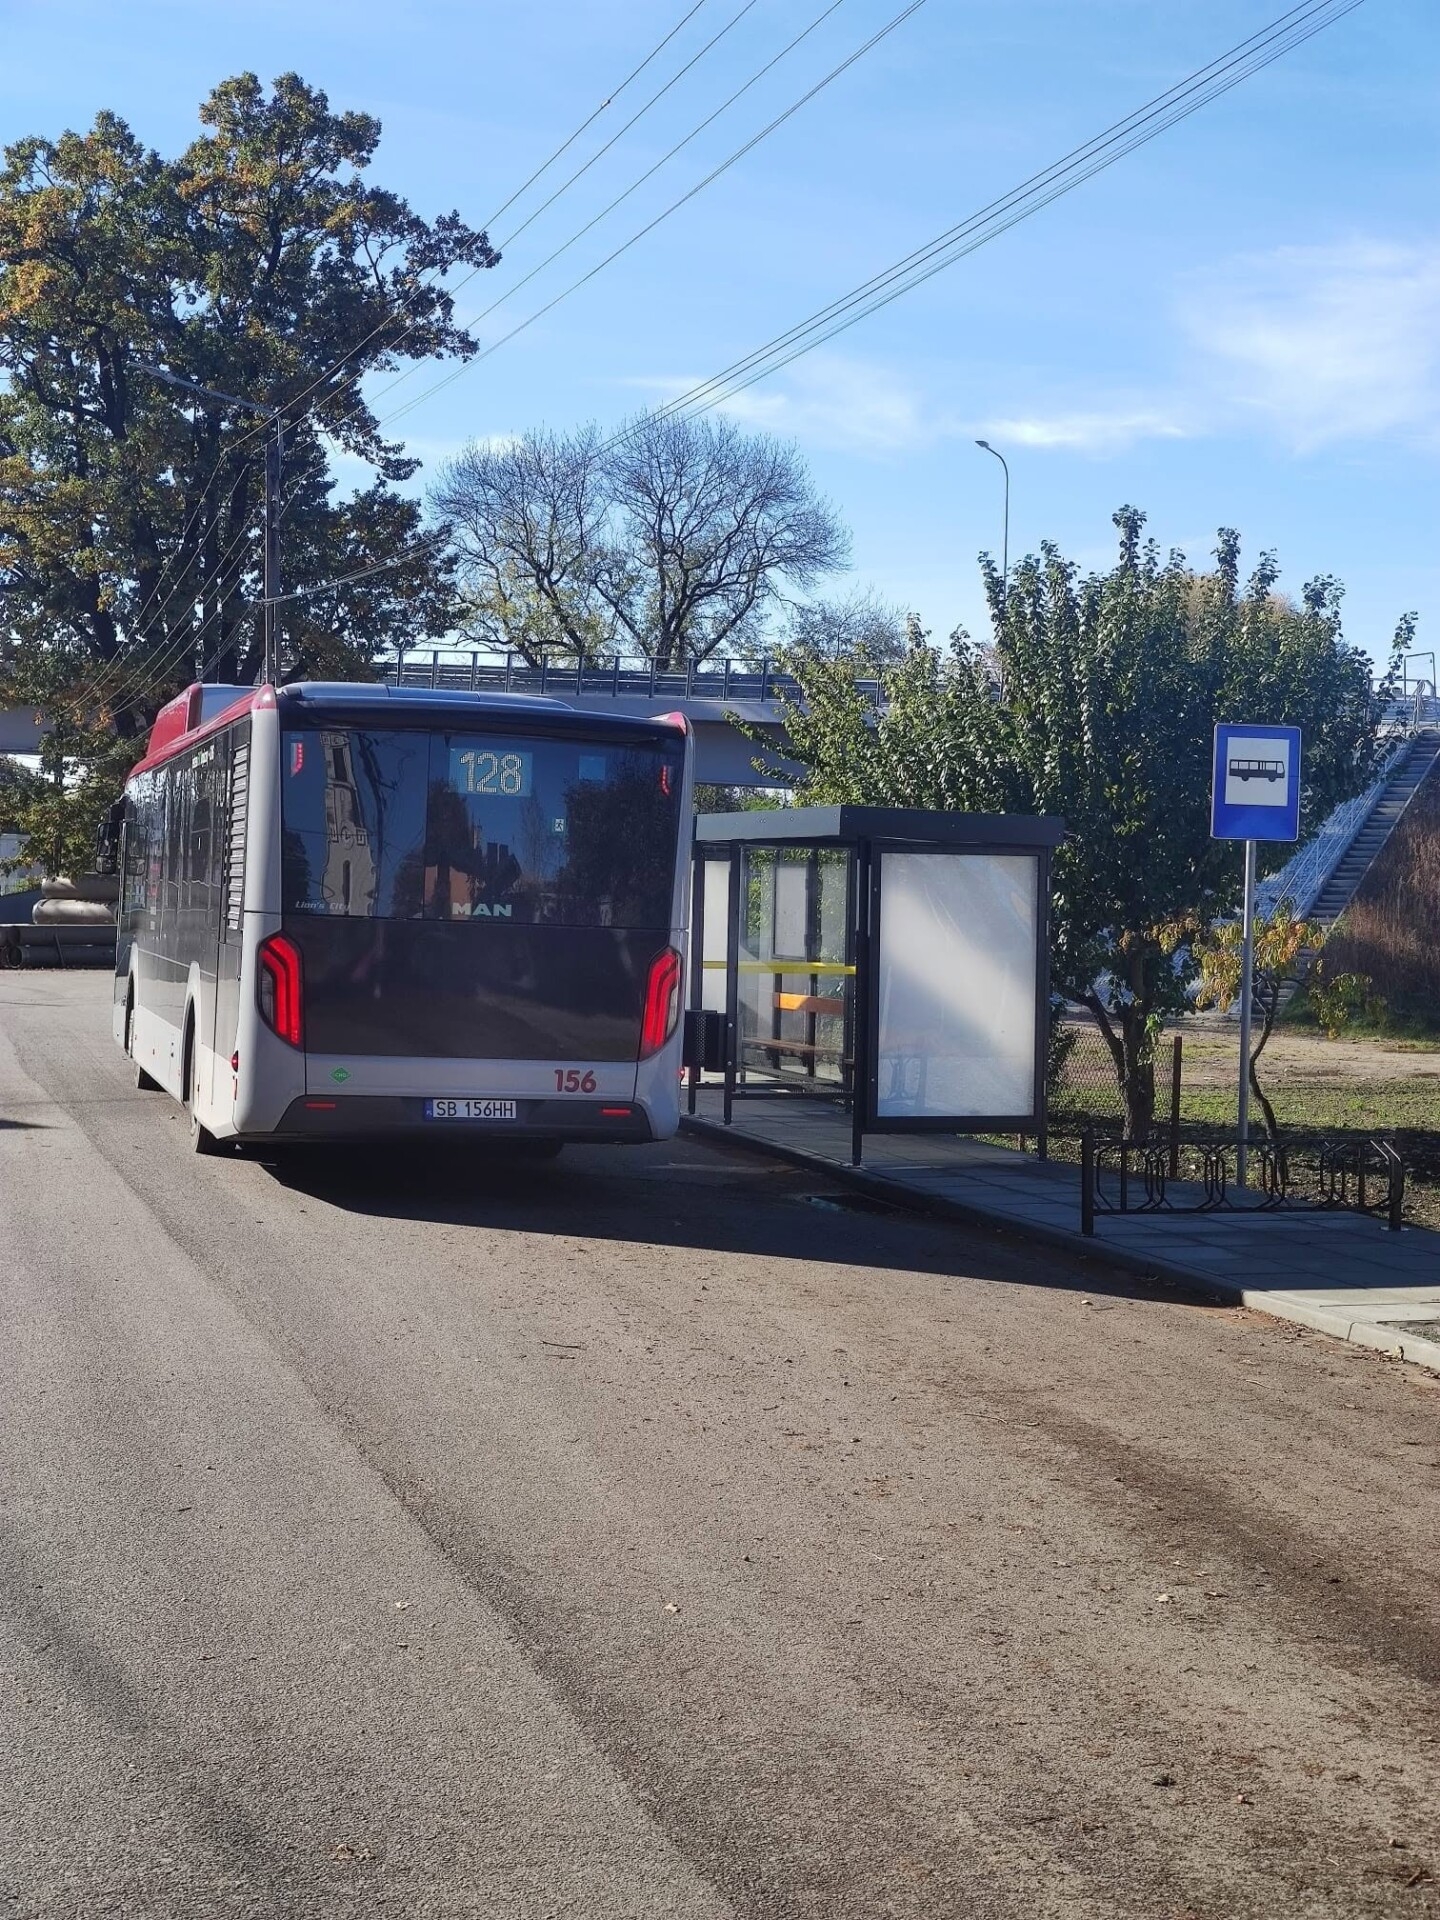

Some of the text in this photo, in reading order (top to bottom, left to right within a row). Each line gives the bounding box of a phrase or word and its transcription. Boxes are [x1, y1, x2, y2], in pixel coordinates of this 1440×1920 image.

[460, 751, 522, 793] 128
[452, 902, 512, 917] MAN
[554, 1069, 597, 1093] 156
[436, 1101, 513, 1118] SB 156HH
